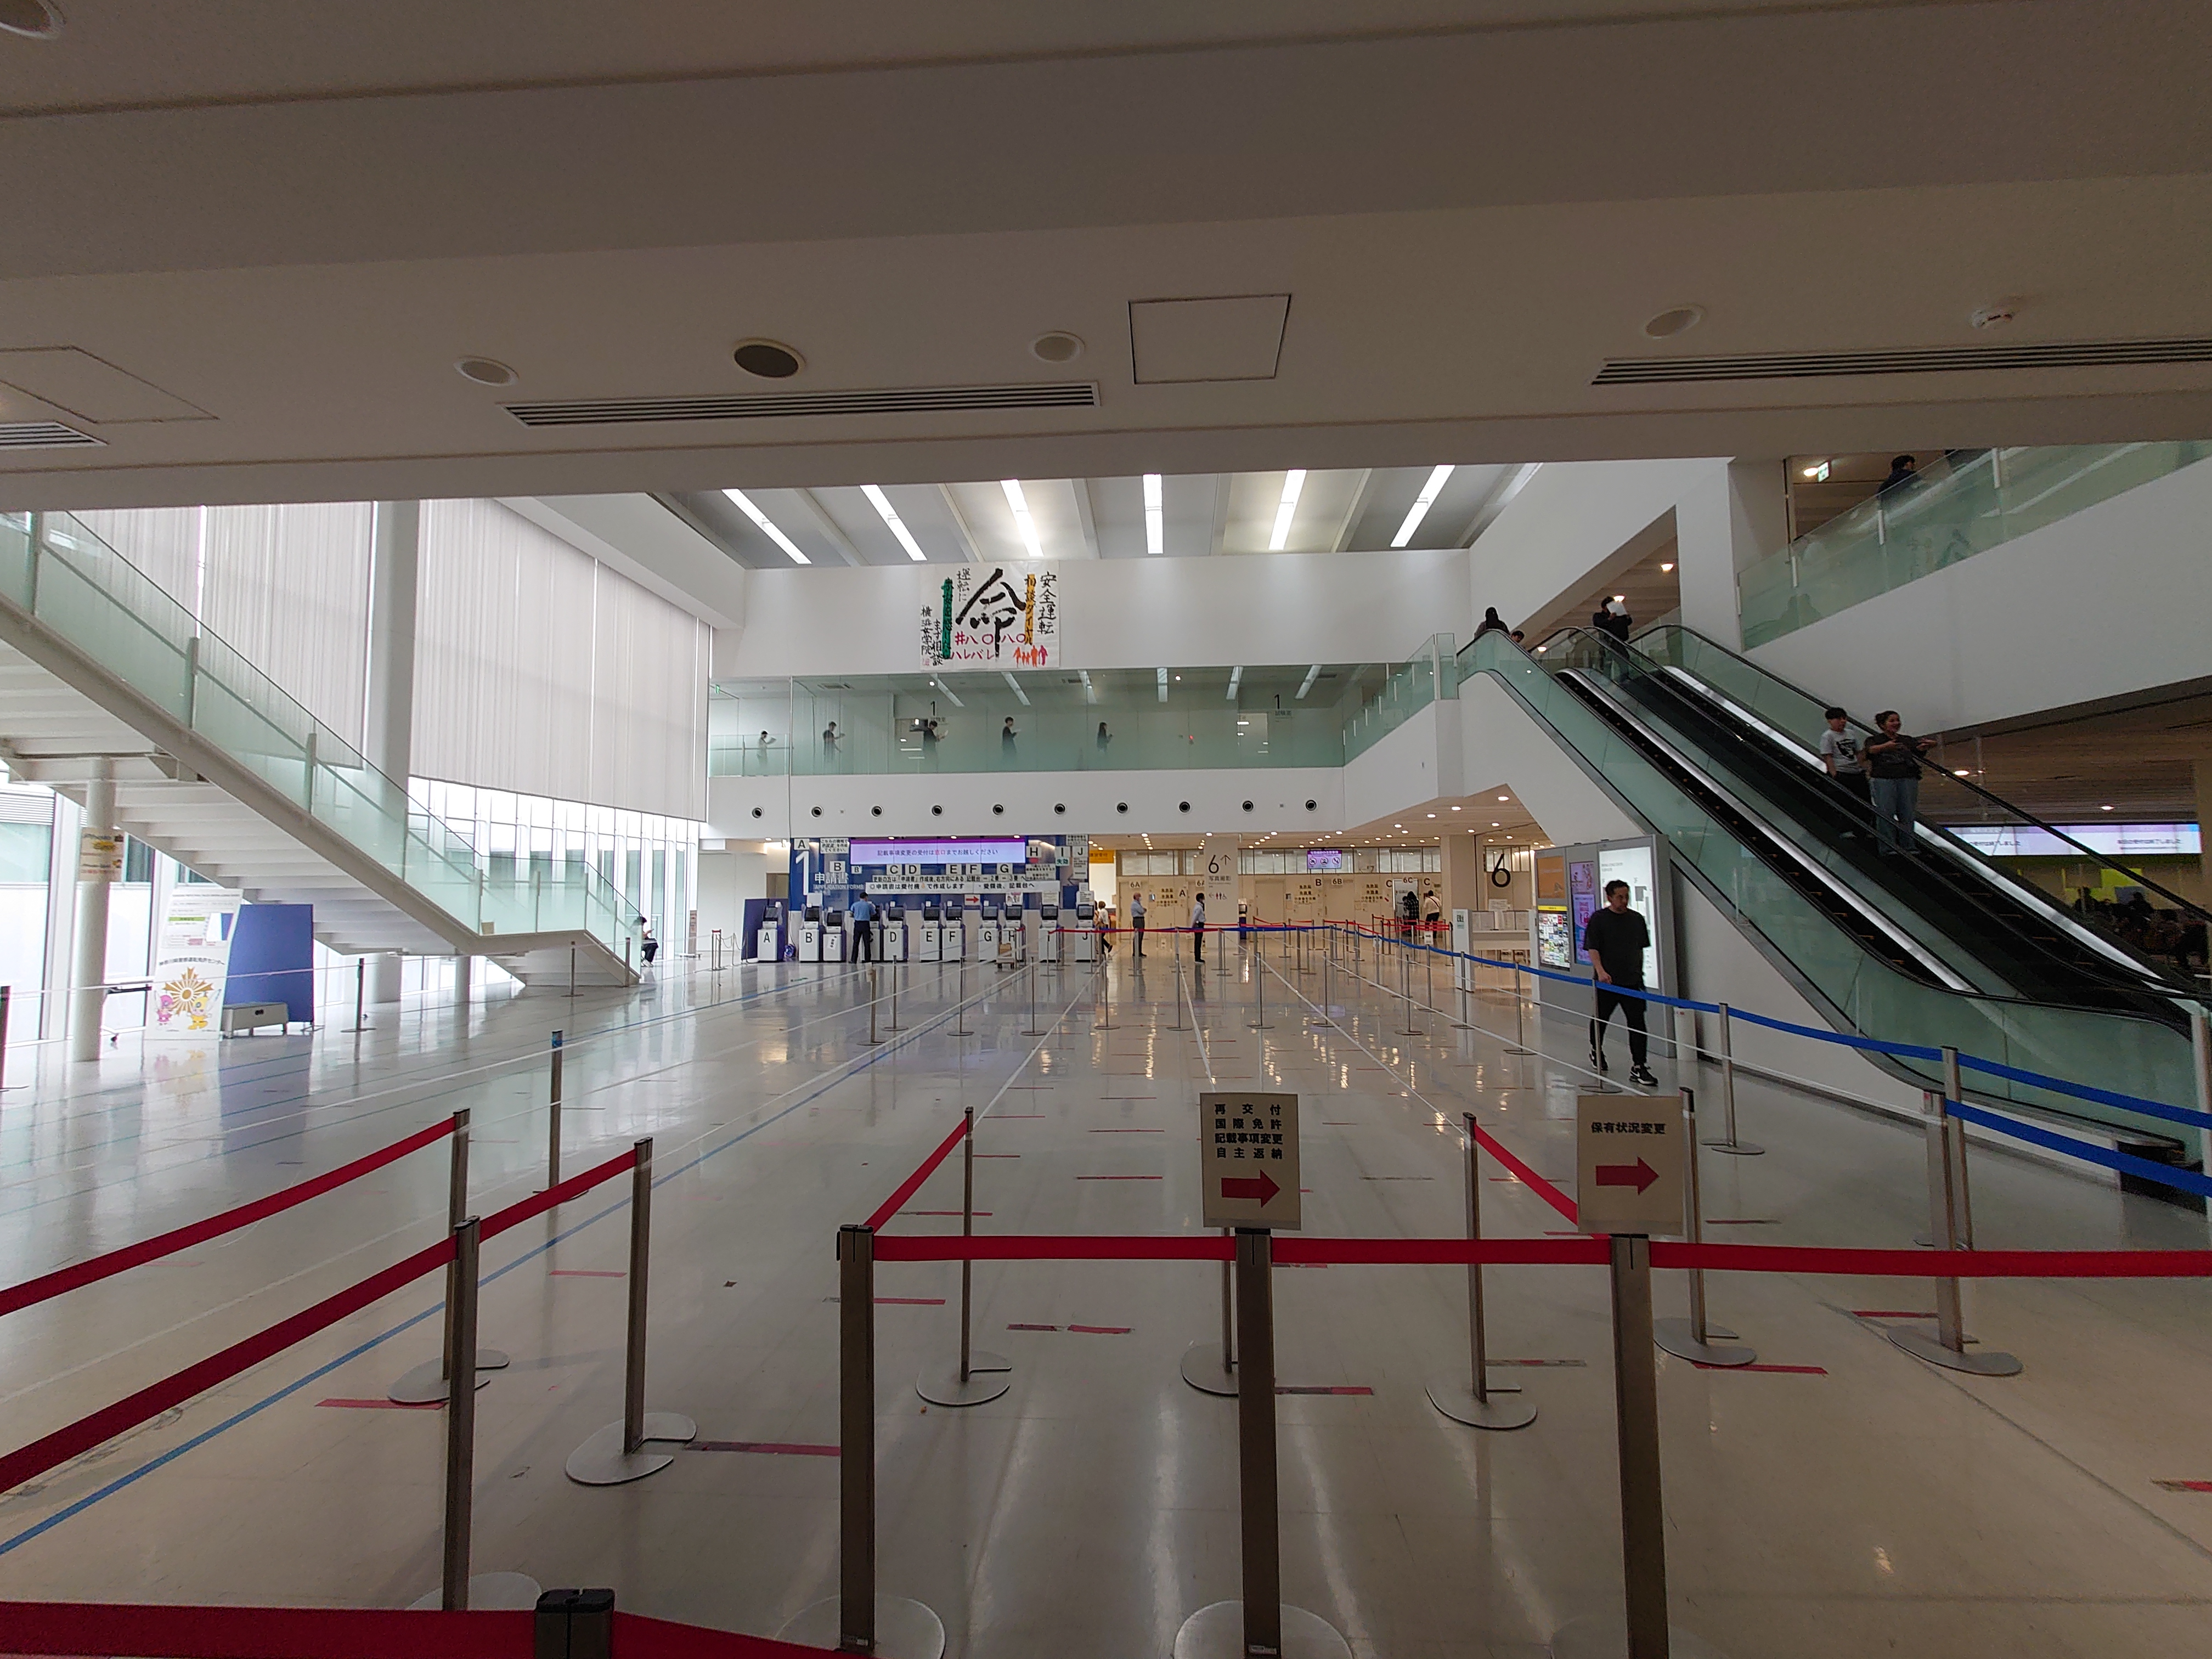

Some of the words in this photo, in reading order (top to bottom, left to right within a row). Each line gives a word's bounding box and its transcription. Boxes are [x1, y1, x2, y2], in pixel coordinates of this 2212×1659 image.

[1037, 571, 1057, 635] 安全運転
[955, 568, 1026, 659] 命
[1274, 694, 1280, 709] 1
[930, 701, 935, 716] 1
[798, 839, 806, 849] A
[1030, 847, 1038, 856] H
[1061, 848, 1063, 856] I
[1077, 848, 1083, 856] J
[834, 862, 841, 871] B
[950, 865, 957, 873] E
[1000, 864, 1009, 873] G
[1209, 855, 1219, 873] 6
[795, 851, 809, 895] 1
[890, 865, 899, 874] C
[909, 865, 917, 874] D
[970, 865, 978, 874] F
[1492, 853, 1511, 888] 6
[763, 932, 770, 943] A
[805, 932, 812, 943] B
[890, 932, 896, 942] D
[926, 932, 933, 941] E
[949, 932, 955, 941] F
[984, 931, 992, 942] G
[1082, 932, 1088, 940] J
[1215, 1118, 1282, 1130] 国際免許
[1591, 1122, 1666, 1134] 保有状況変更
[1215, 1133, 1283, 1144] 記載事項変更
[1217, 1147, 1283, 1159] 自主返納
